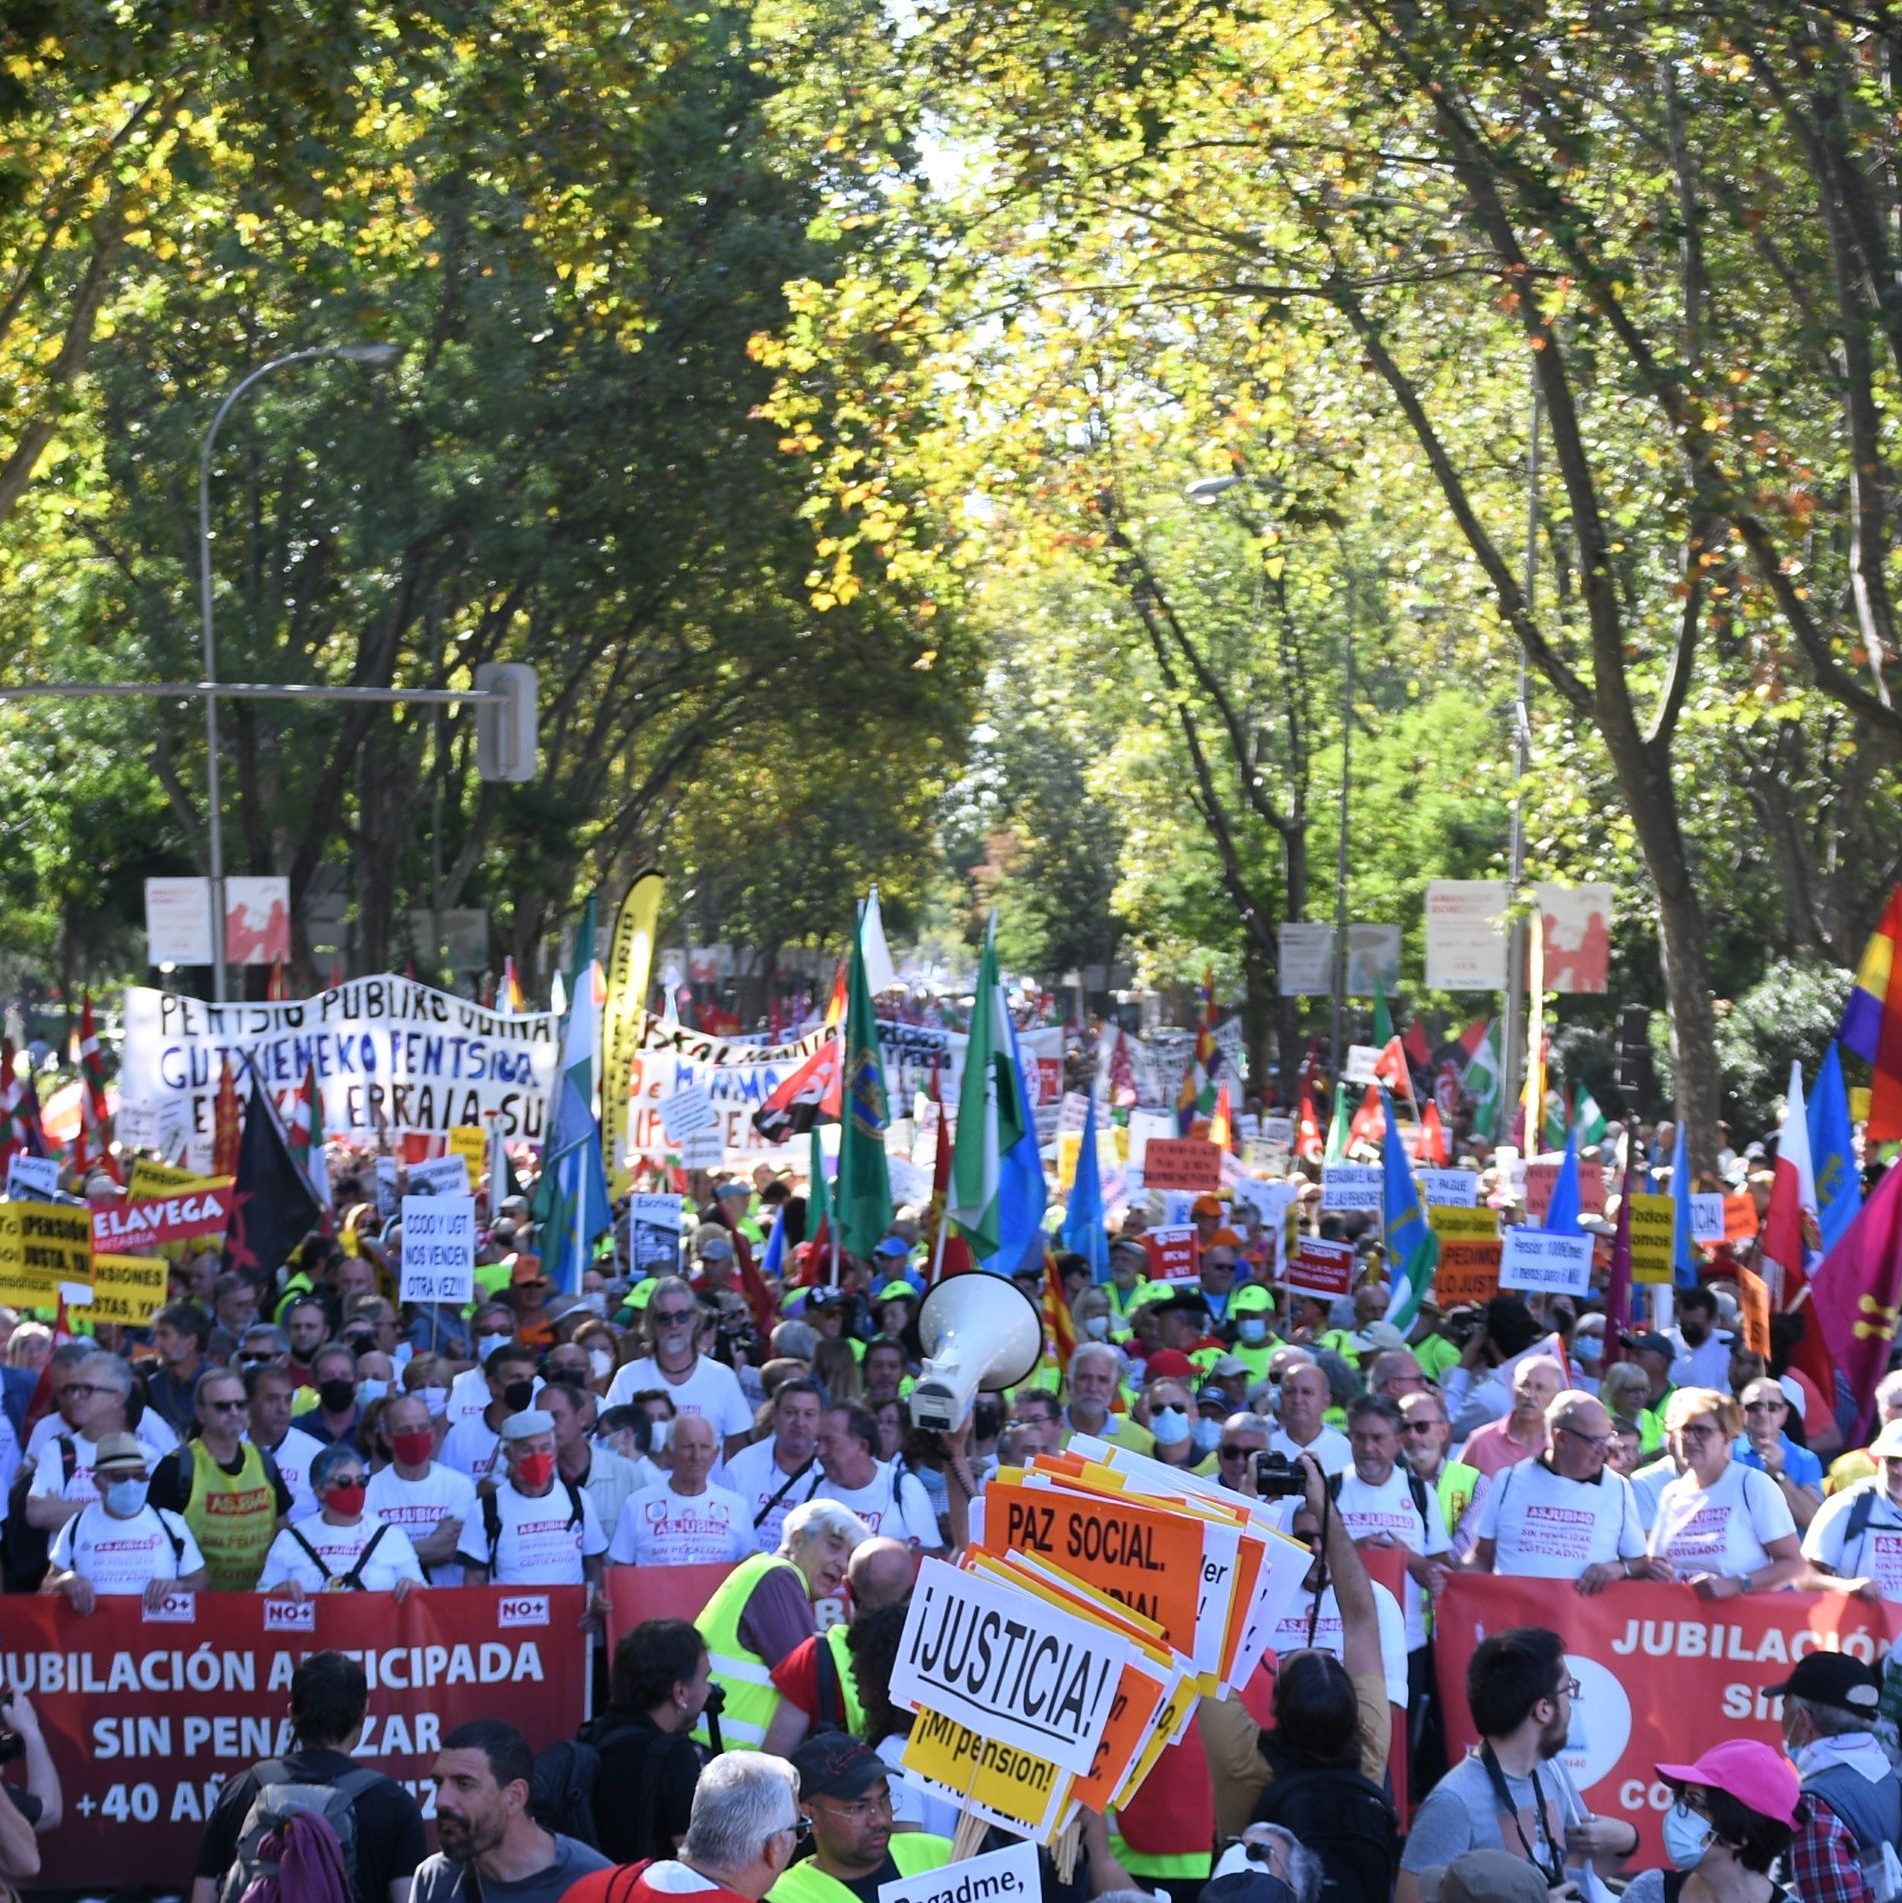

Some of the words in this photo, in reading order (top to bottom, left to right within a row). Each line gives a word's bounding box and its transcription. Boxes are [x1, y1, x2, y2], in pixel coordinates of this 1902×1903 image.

[93, 1194, 224, 1237] ELAVEGA
[1008, 1502, 1055, 1552] PAZ
[1067, 1512, 1165, 1571] SOCIAL.
[268, 1603, 311, 1621] NO+
[503, 1602, 545, 1616] NO+
[909, 1586, 1111, 1738] ¡JUSTICIA!
[94, 1715, 171, 1759] SIN
